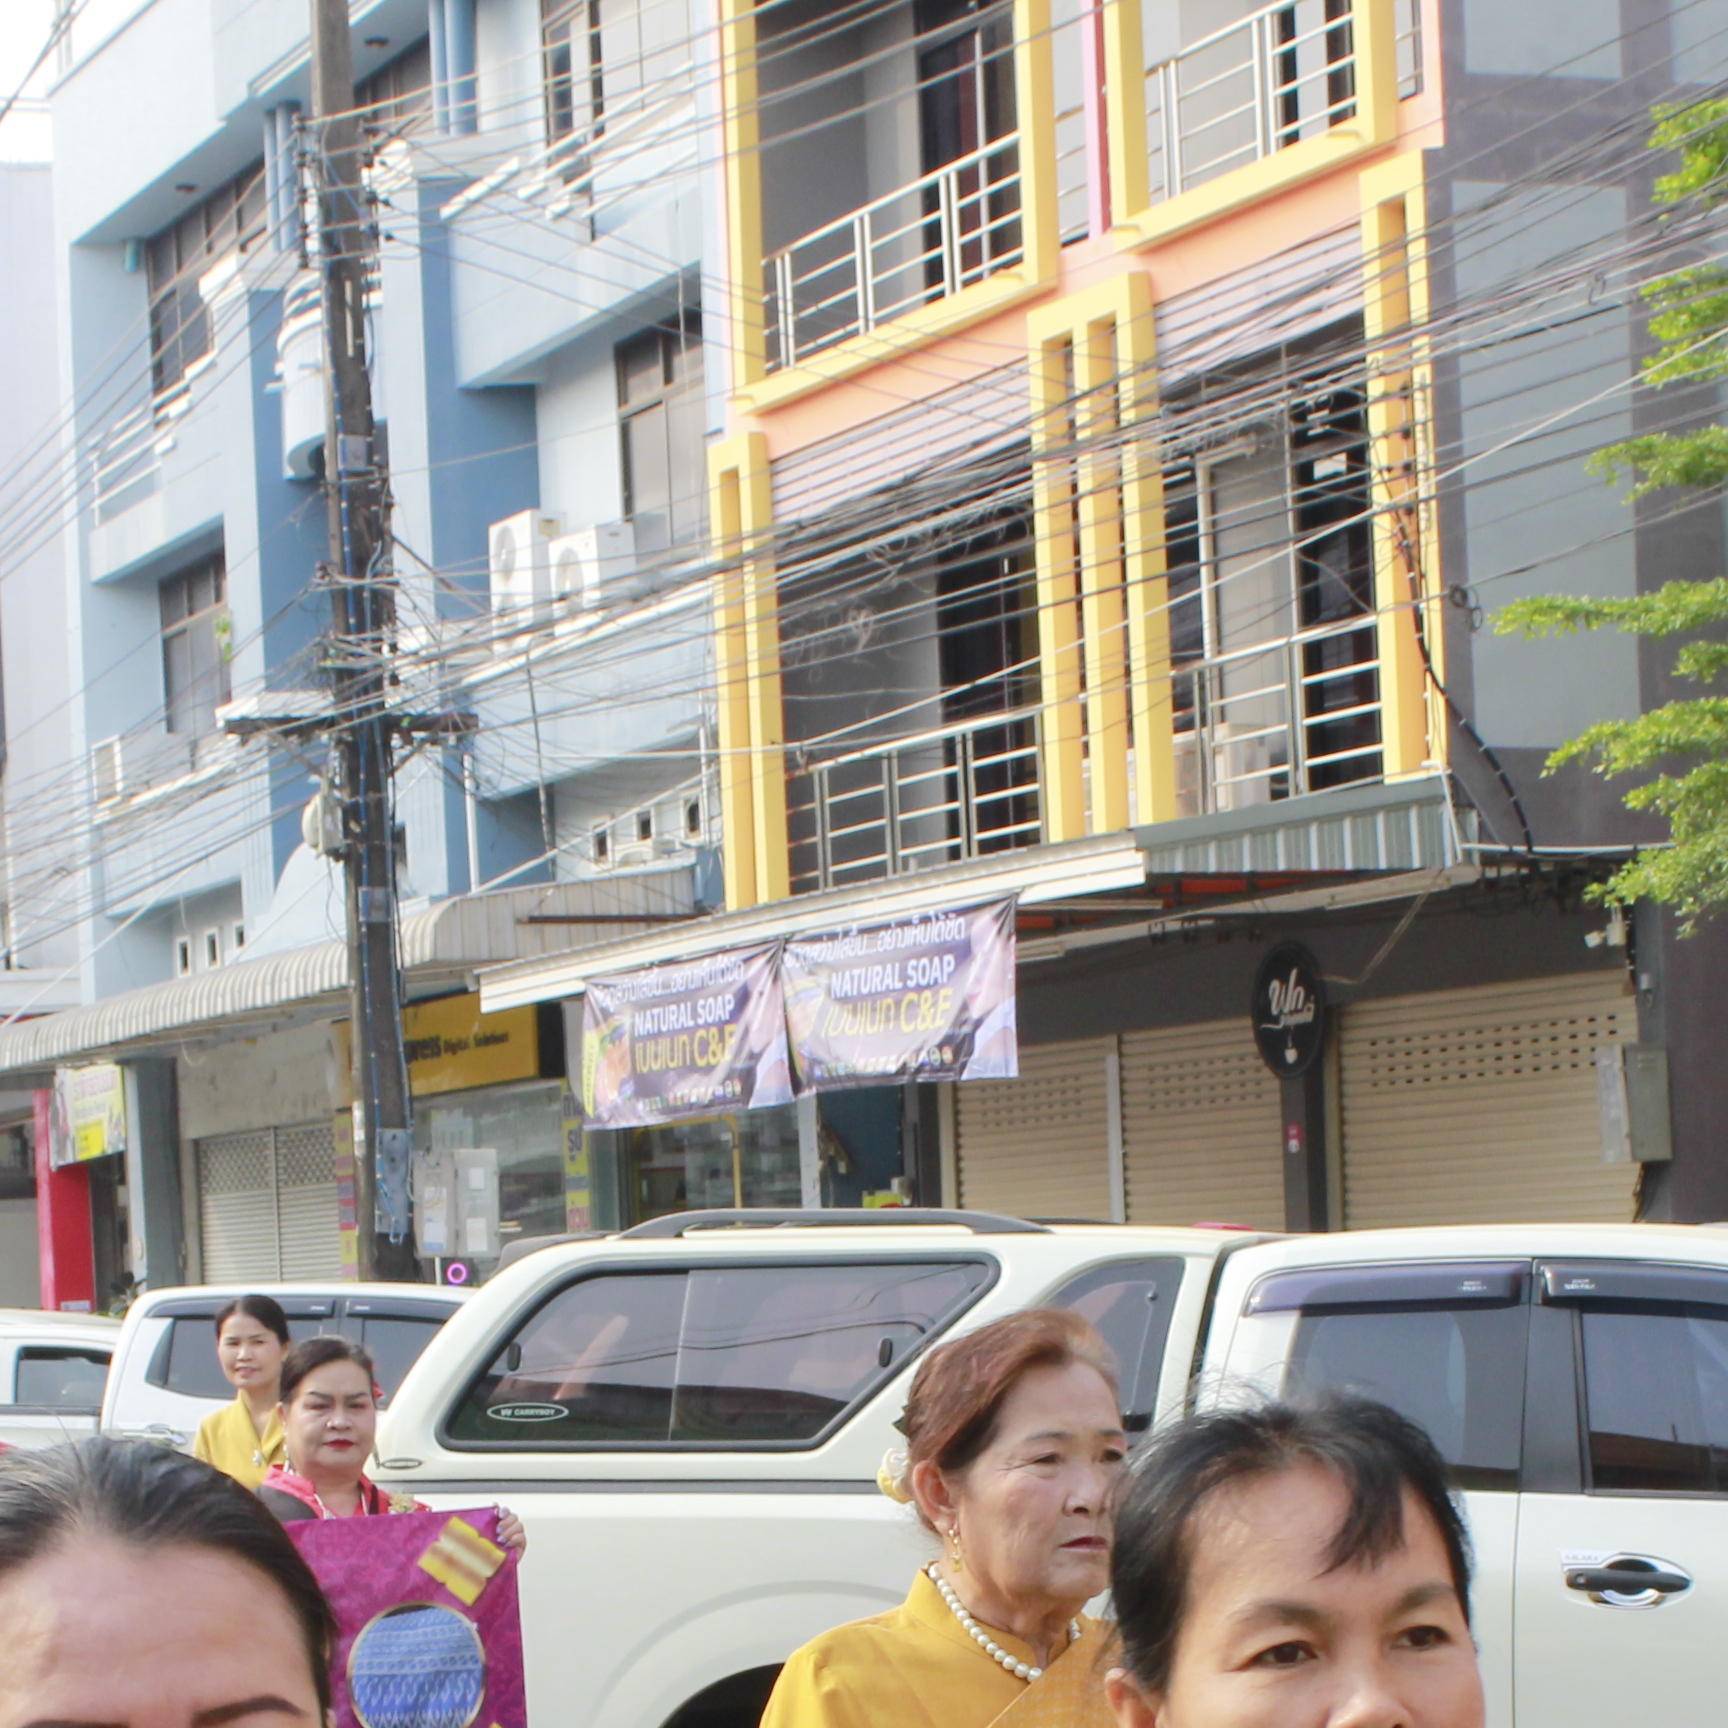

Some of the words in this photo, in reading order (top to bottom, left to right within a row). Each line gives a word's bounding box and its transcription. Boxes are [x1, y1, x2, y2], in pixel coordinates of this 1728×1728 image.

[830, 963, 903, 1000] NATURAL
[906, 953, 956, 988] SOAP
[633, 1004, 695, 1037] NATURAL
[696, 994, 735, 1026] SOAP
[900, 987, 954, 1035] C&E
[693, 1022, 739, 1068] C&E
[514, 1408, 556, 1416] CARRYBOY
